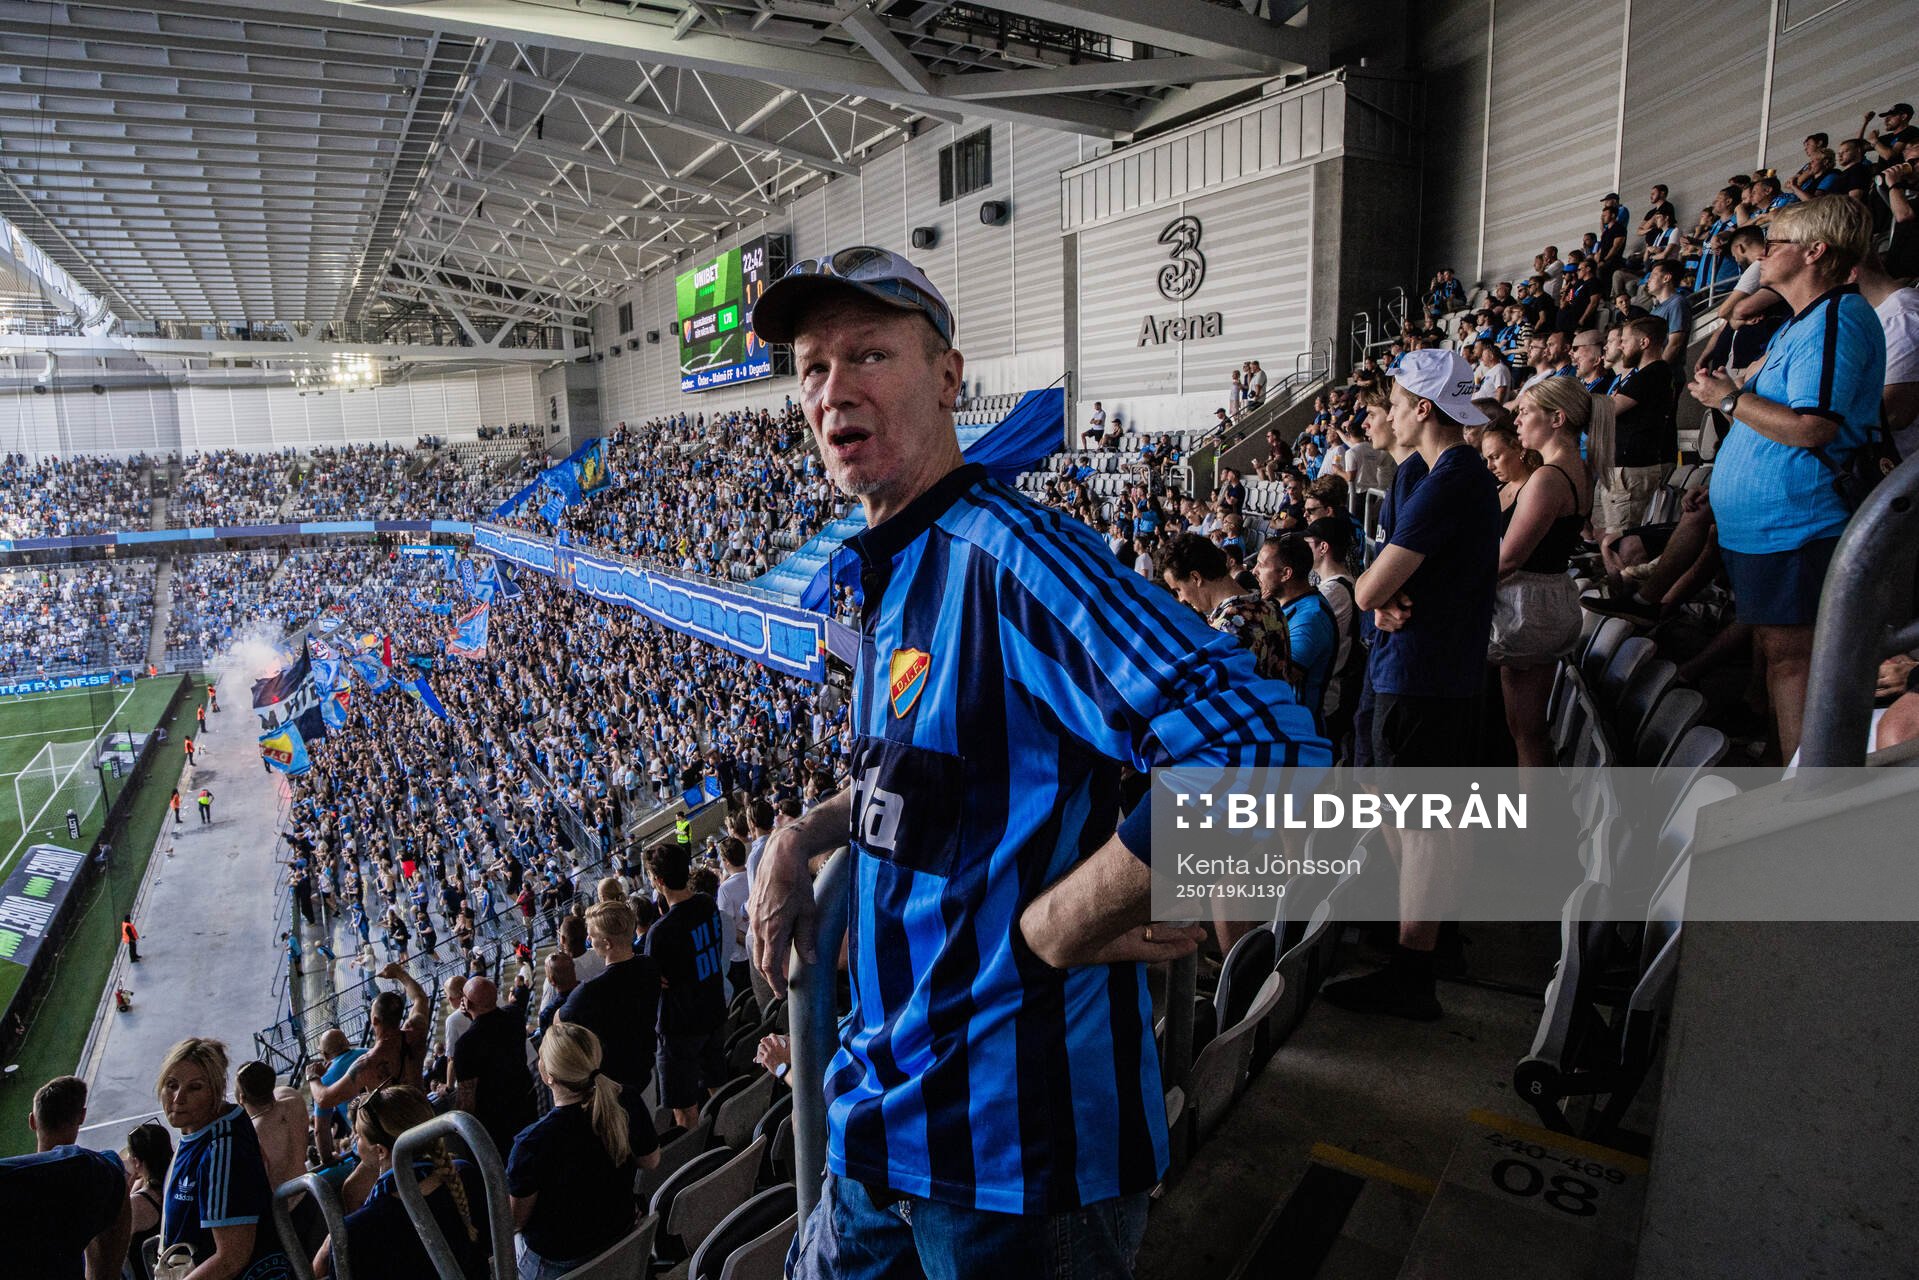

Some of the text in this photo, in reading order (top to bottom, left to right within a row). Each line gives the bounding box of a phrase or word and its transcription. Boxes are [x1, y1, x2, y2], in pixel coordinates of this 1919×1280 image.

[694, 263, 719, 289] UNIBET
[1137, 311, 1222, 347] Arena
[576, 558, 765, 650] DJURGÅRDENS
[60, 675, 110, 688] DIF.SE
[896, 661, 923, 692] D.I.F.
[68, 817, 80, 839] SELECT
[1530, 1080, 1542, 1095] 8
[1485, 1132, 1626, 1185] 440-469
[1491, 1158, 1599, 1217] 08
